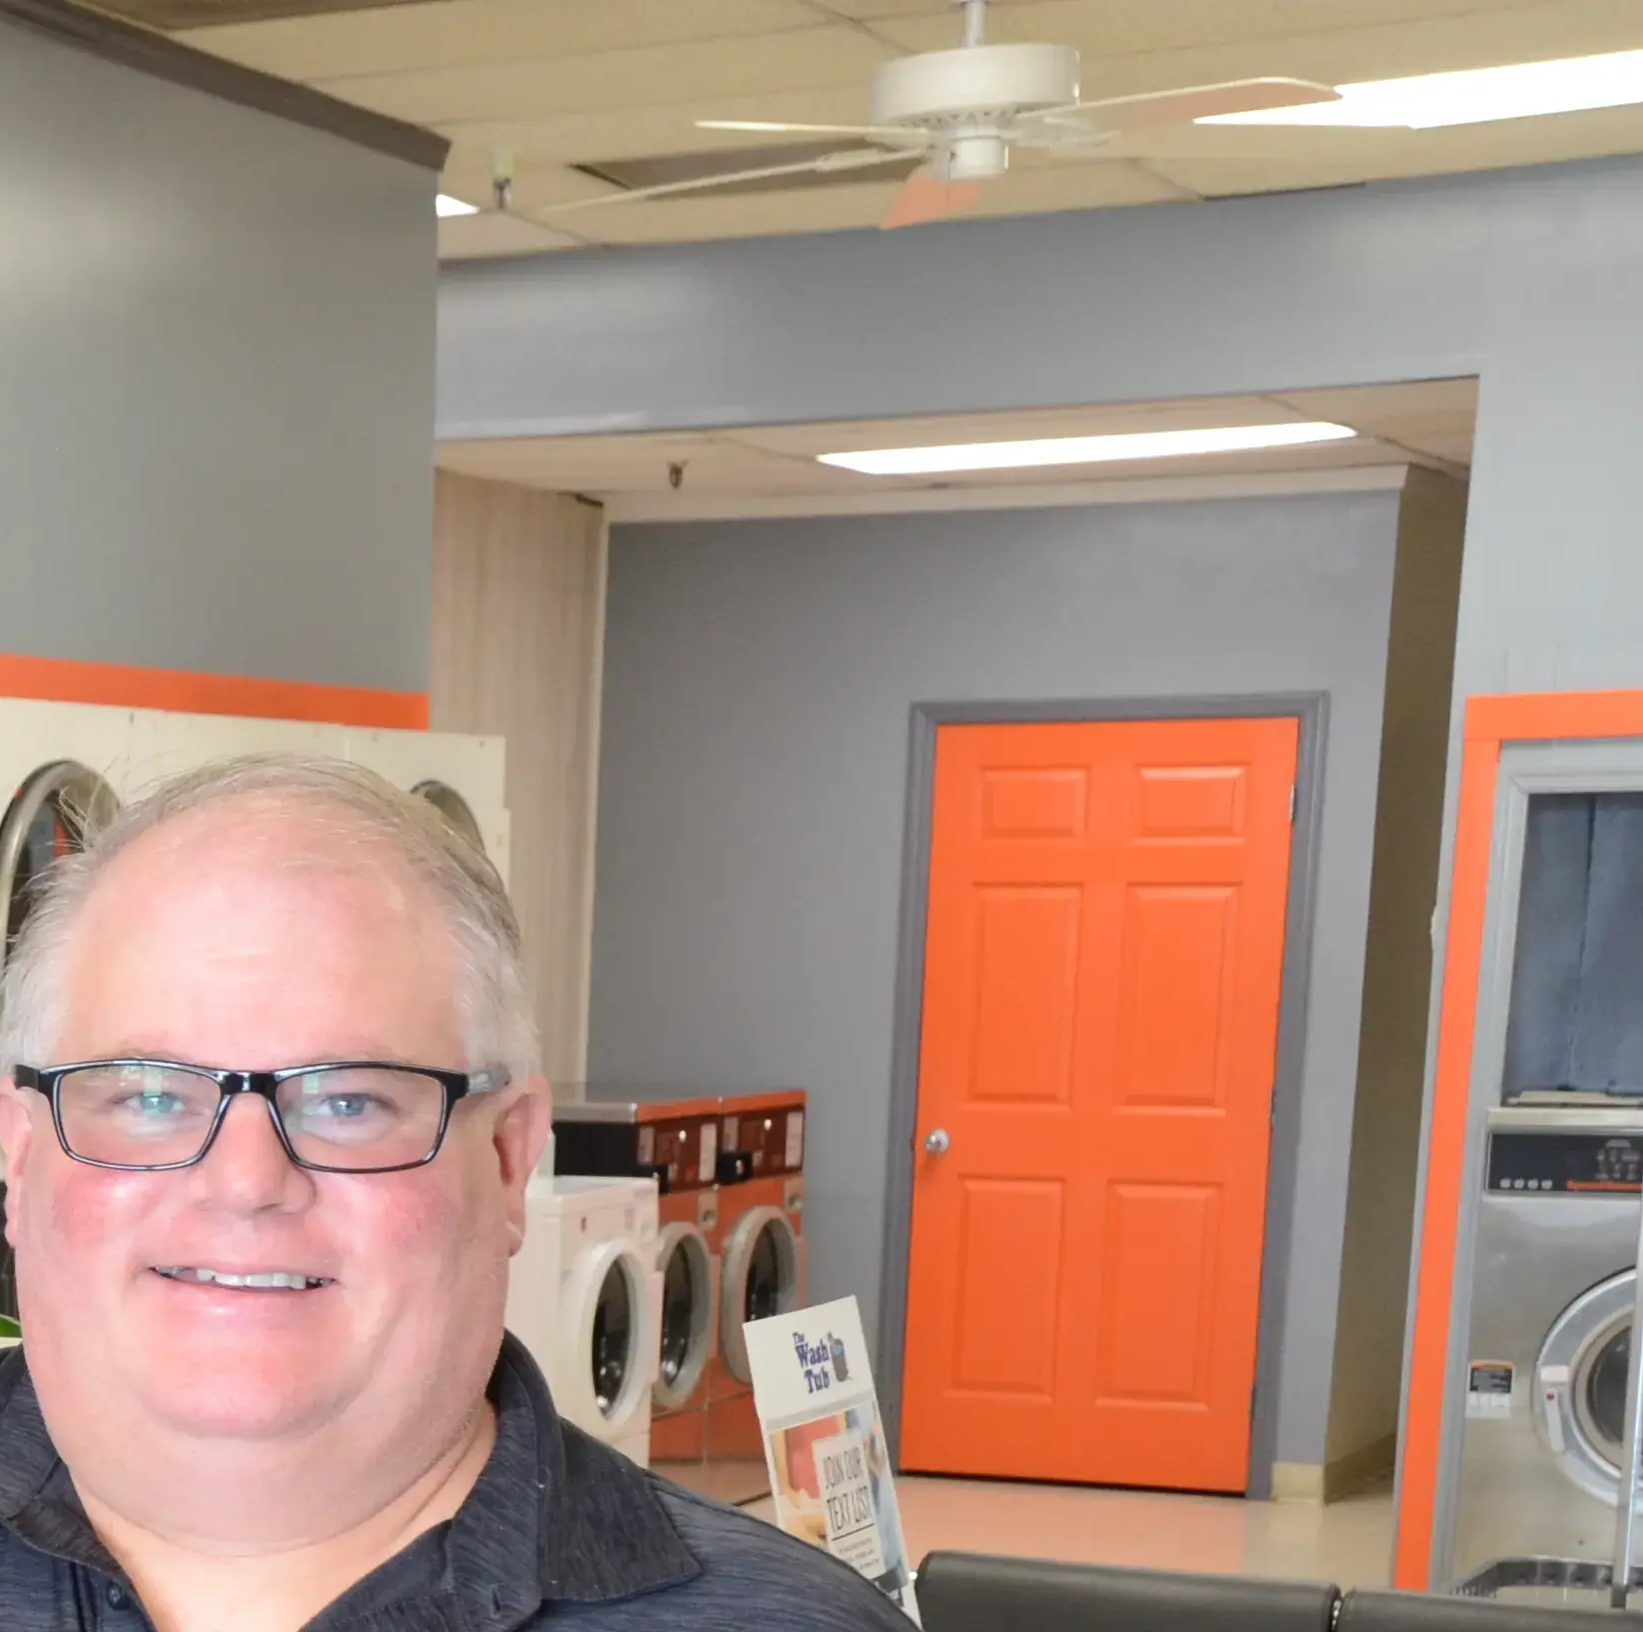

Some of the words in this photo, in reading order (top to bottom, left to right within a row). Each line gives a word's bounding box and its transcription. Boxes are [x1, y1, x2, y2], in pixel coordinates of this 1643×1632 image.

[792, 1331, 806, 1346] The
[795, 1340, 830, 1369] Wash
[804, 1368, 830, 1394] Tub
[822, 1454, 844, 1489] JOIN
[844, 1446, 863, 1481] OUR
[827, 1494, 853, 1532] TEXT
[851, 1485, 873, 1525] LIST
